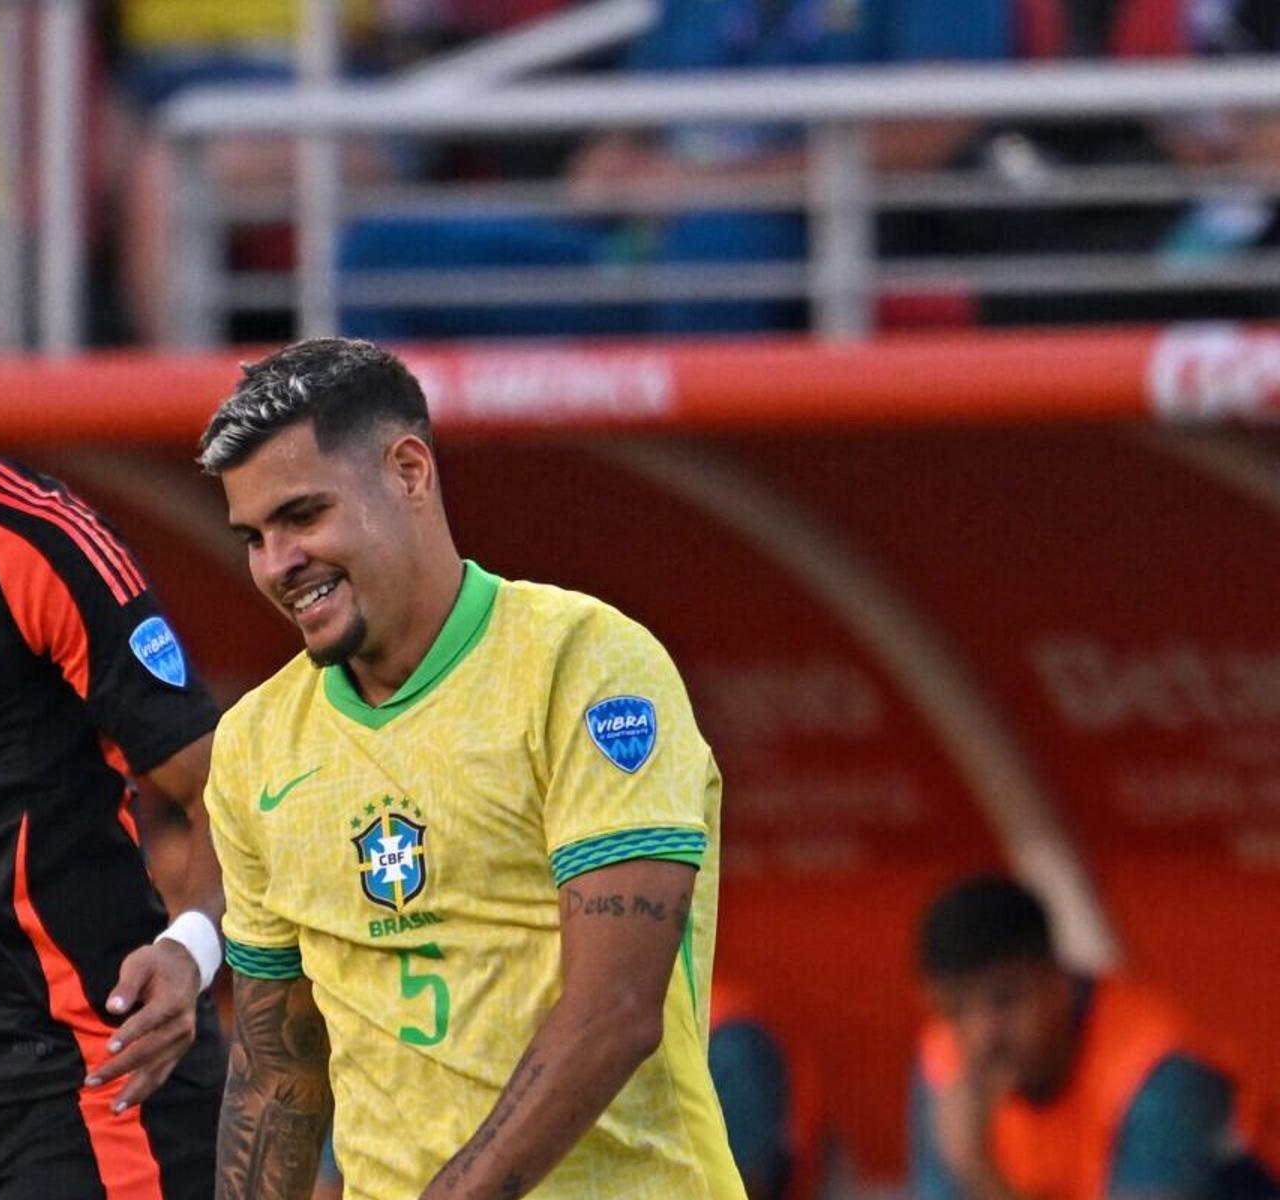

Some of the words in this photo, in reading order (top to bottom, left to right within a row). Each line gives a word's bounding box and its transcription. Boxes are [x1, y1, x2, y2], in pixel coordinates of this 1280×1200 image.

[596, 714, 648, 734] VIBRA
[378, 851, 406, 866] CBF
[368, 911, 445, 938] BRASIL
[398, 941, 450, 1046] 5
